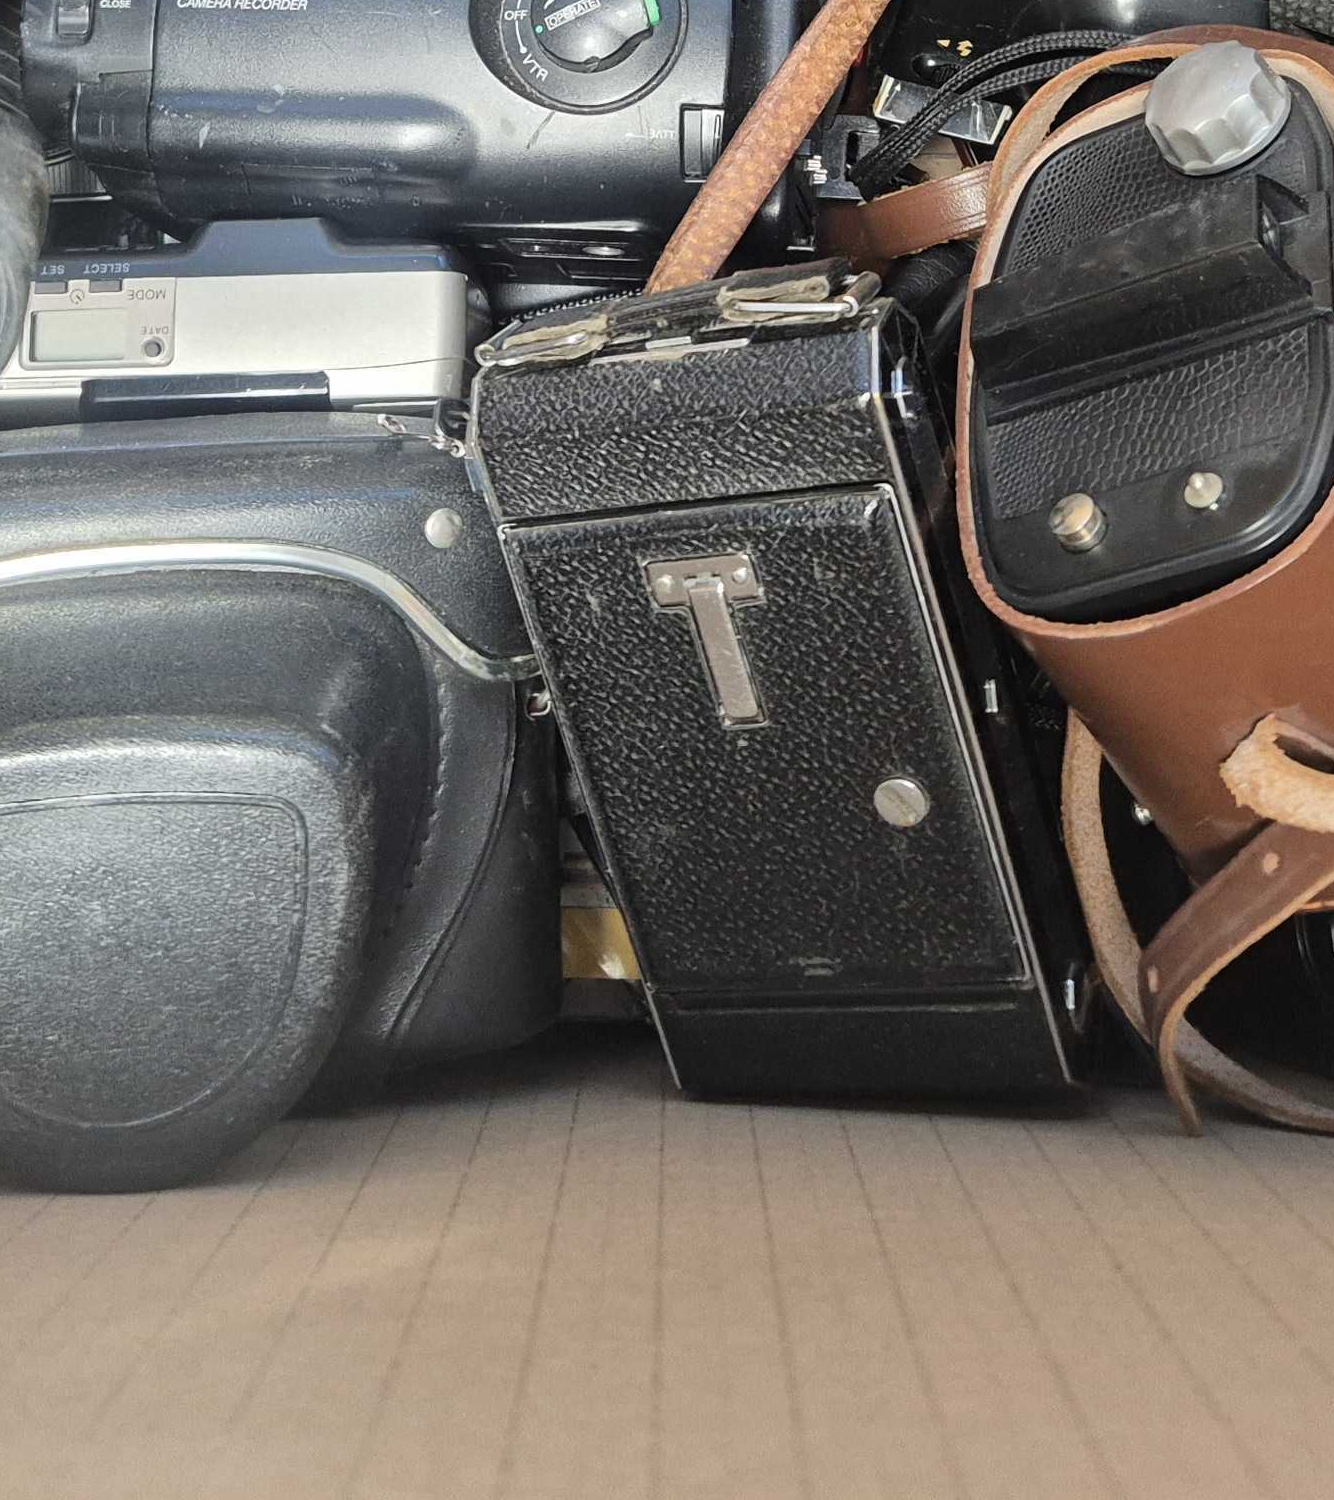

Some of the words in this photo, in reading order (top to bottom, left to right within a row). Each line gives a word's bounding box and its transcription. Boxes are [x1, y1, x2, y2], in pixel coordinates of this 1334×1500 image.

[99, 0, 132, 9] CLOSE
[503, 10, 529, 22] OFF
[522, 52, 550, 82] VTR
[40, 263, 66, 276] SET
[82, 262, 131, 275] SELECT
[127, 288, 167, 301] MODE
[140, 325, 169, 336] DATE
